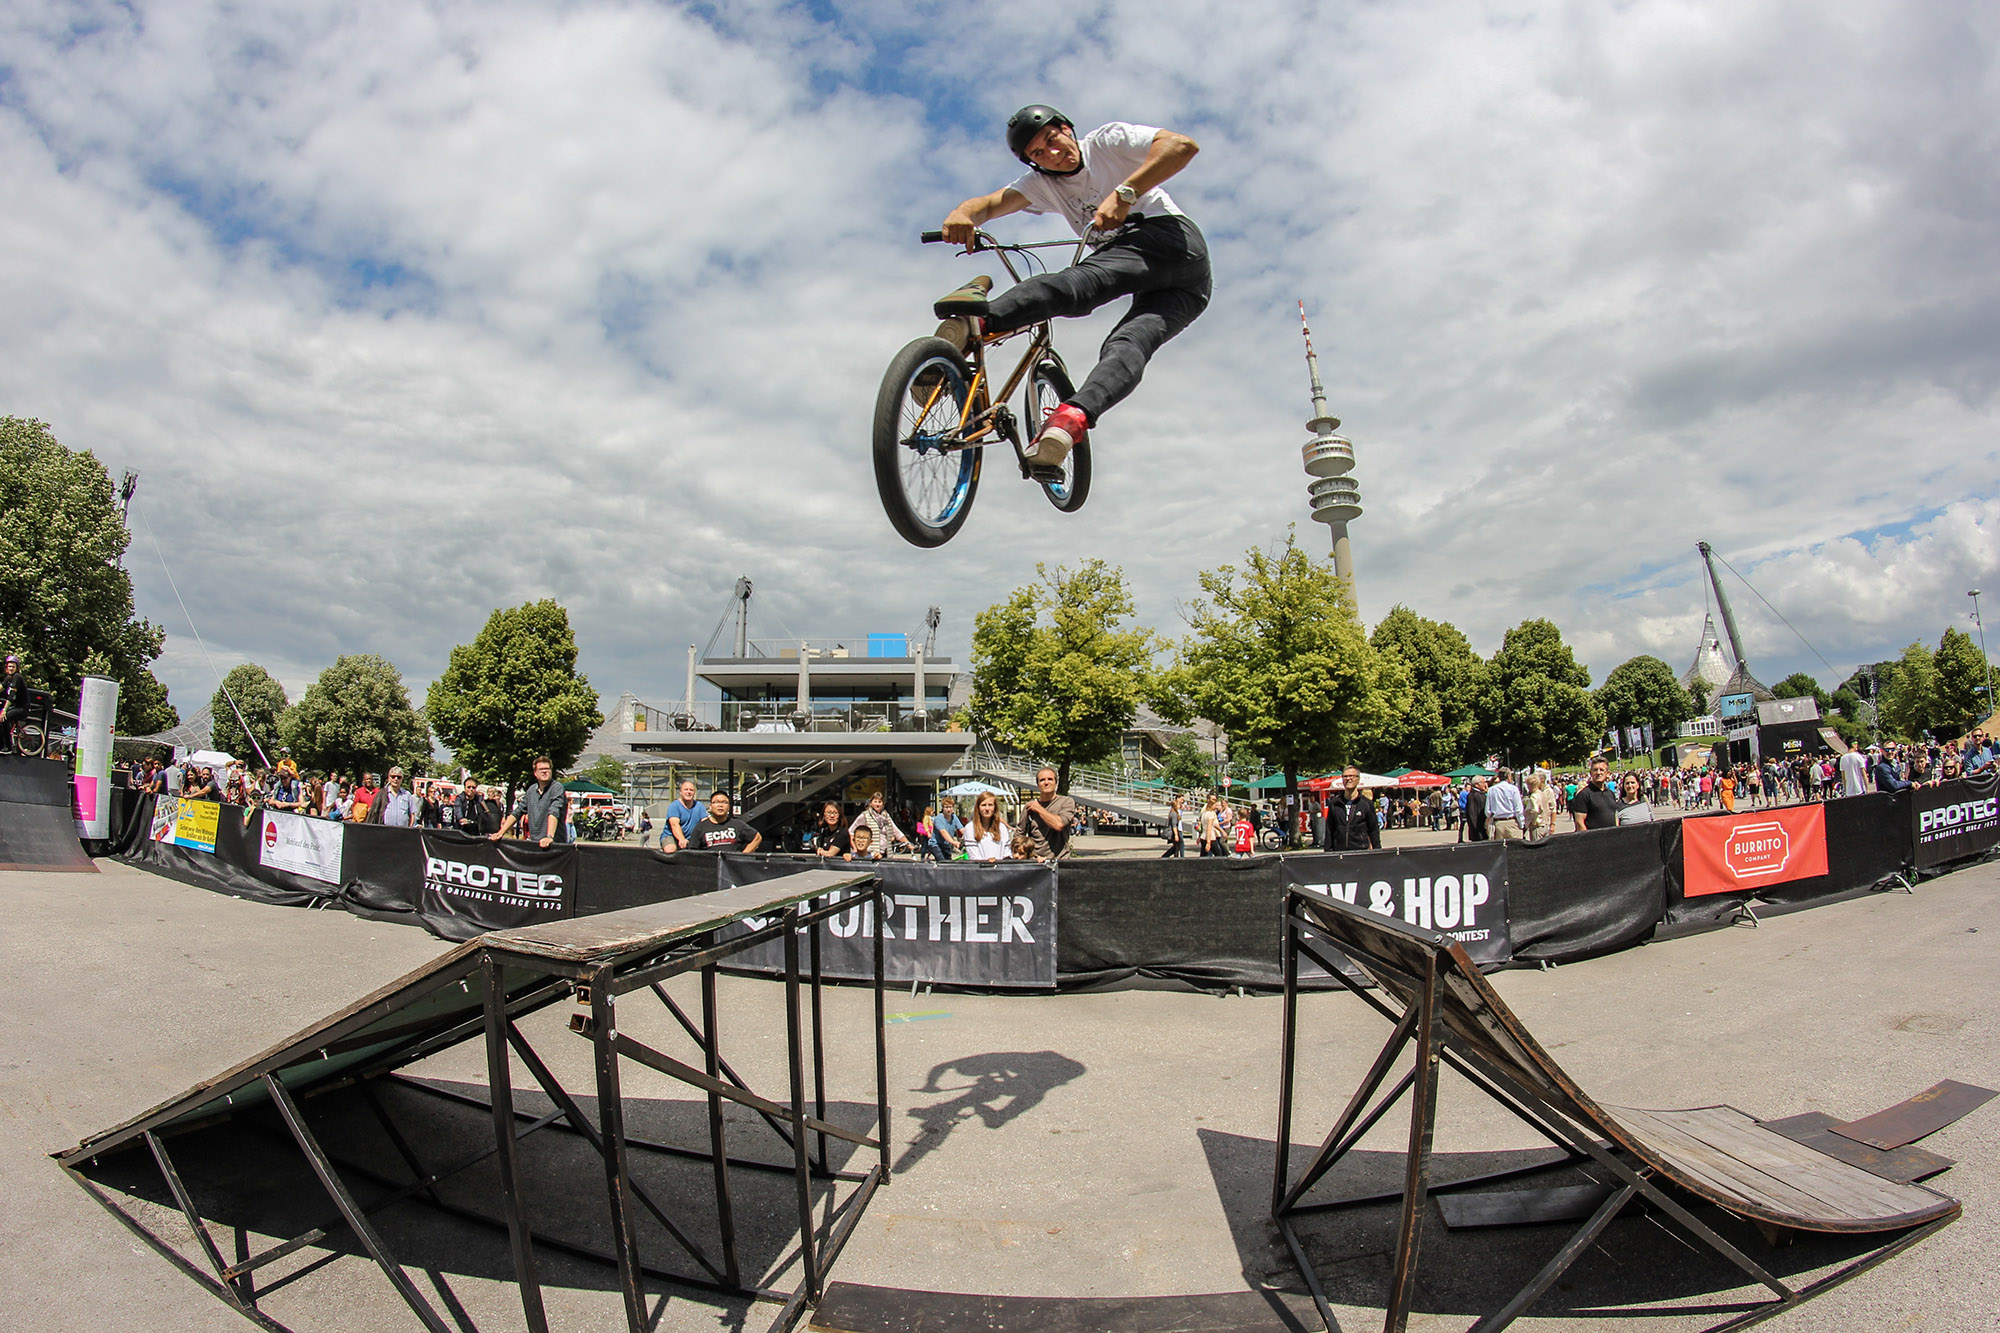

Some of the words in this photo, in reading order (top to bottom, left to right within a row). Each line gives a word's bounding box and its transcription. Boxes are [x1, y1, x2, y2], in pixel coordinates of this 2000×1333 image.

[1920, 797, 1998, 832] PRO-TEC
[1236, 828, 1246, 841] 12
[1734, 837, 1781, 856] BURRITO
[1744, 854, 1771, 862] COMPANY
[426, 857, 563, 897] PRO-TEC
[424, 882, 443, 892] THE
[446, 886, 493, 901] ORIGINAL
[499, 896, 530, 908] SINCE
[535, 901, 562, 911] 1973
[1403, 873, 1489, 930] HOP
